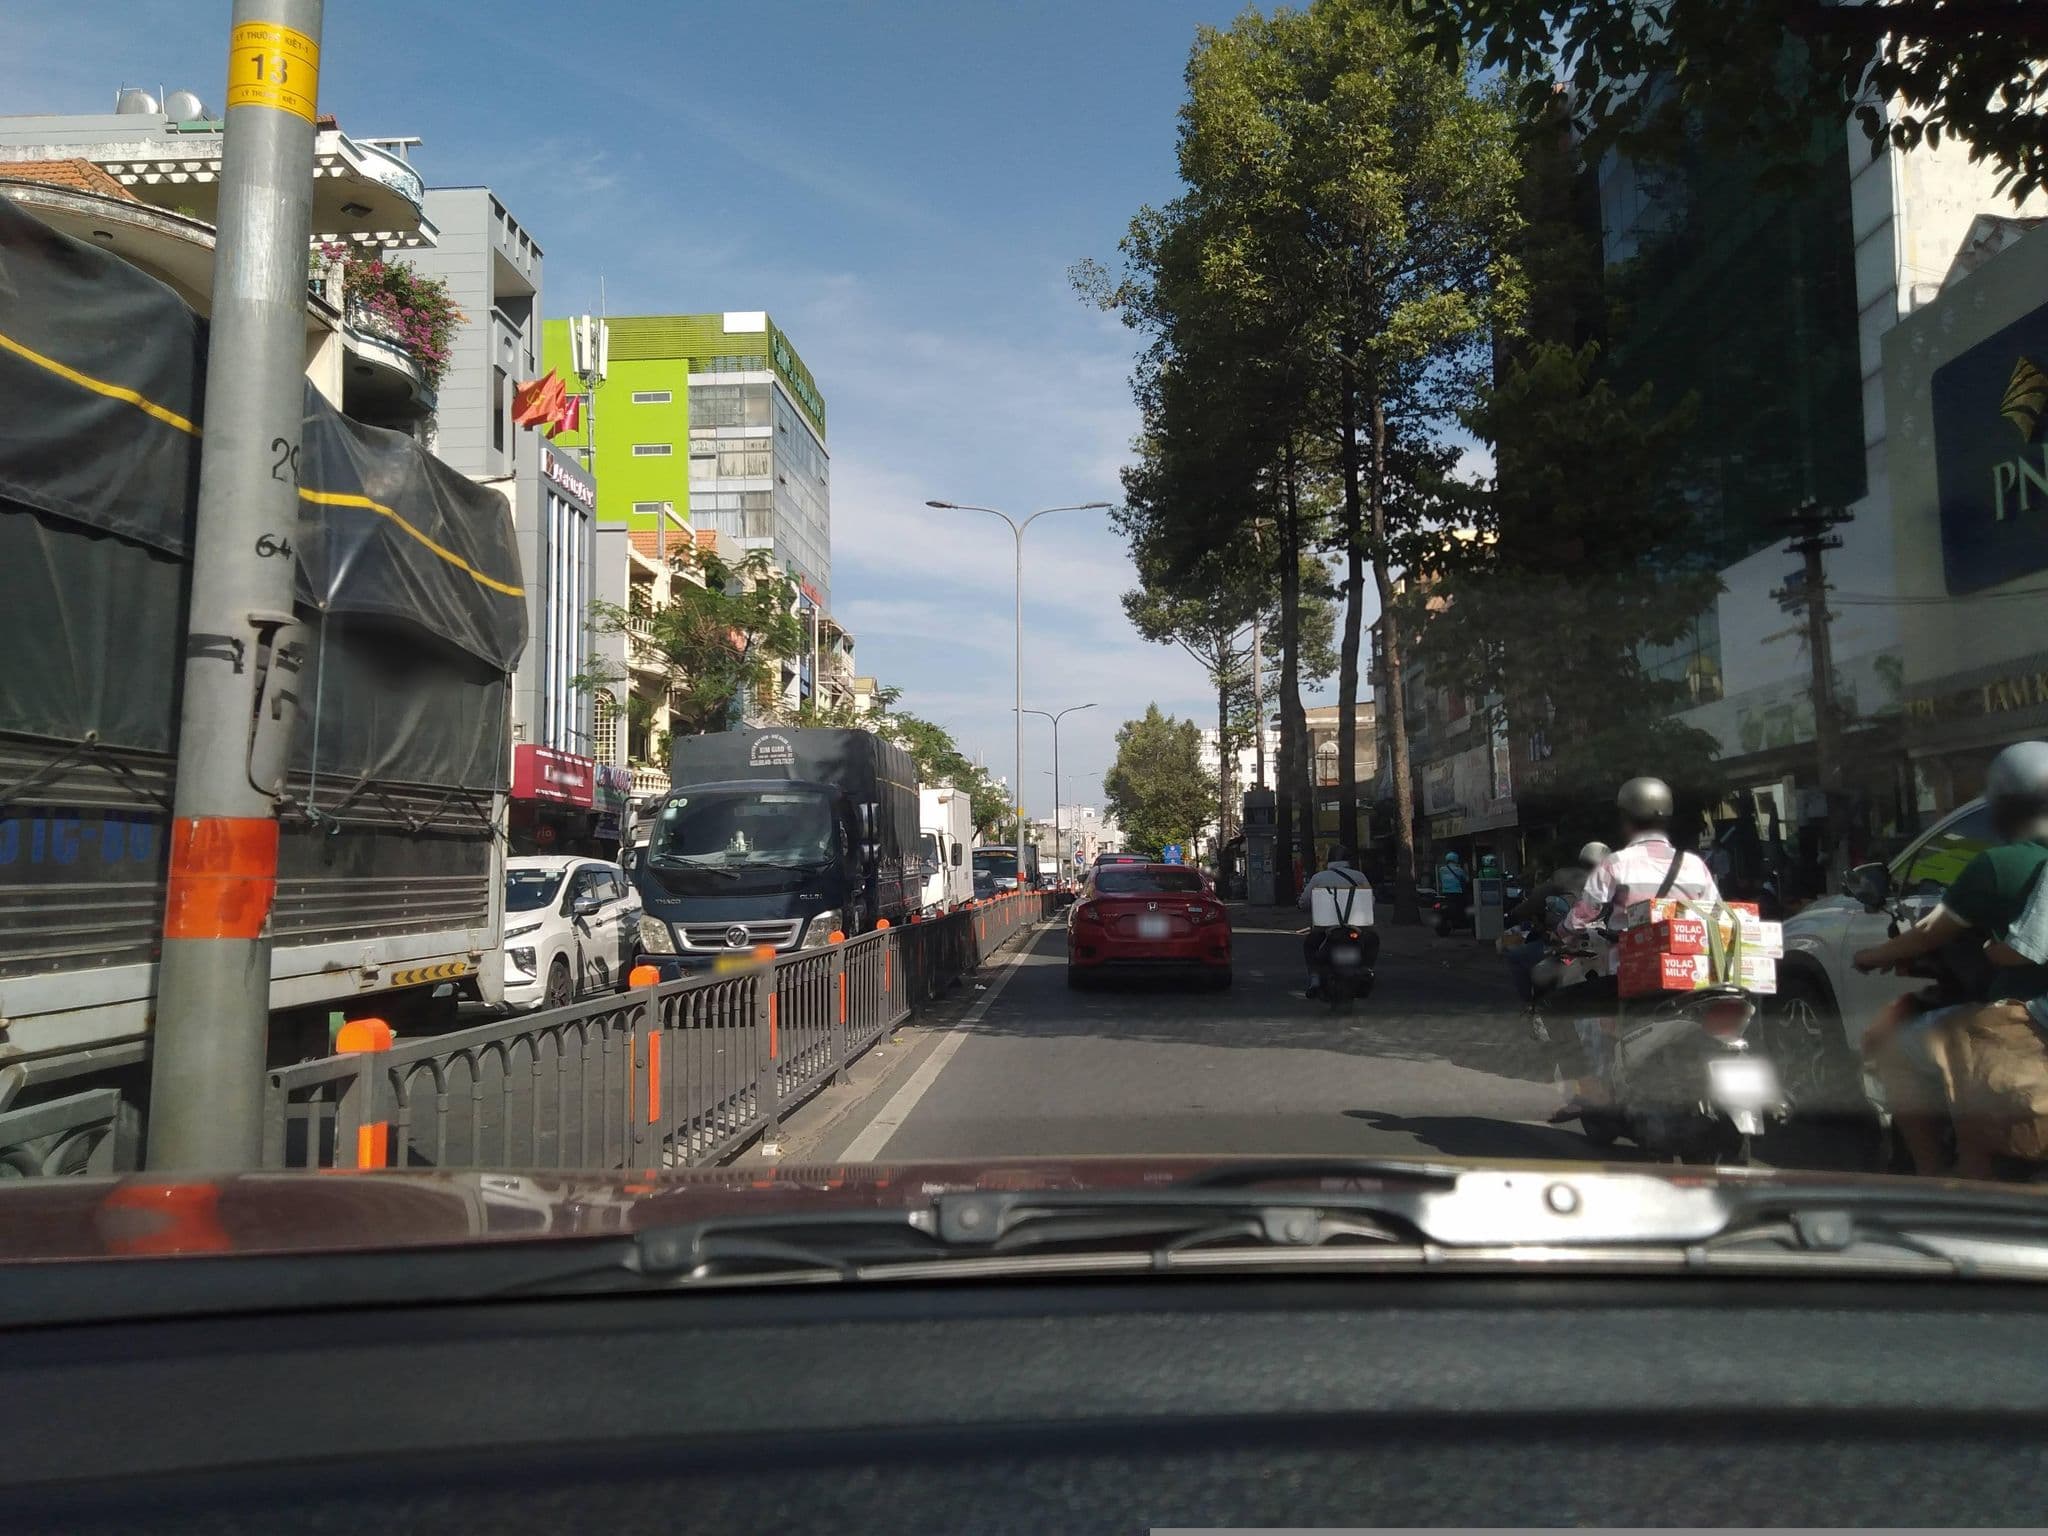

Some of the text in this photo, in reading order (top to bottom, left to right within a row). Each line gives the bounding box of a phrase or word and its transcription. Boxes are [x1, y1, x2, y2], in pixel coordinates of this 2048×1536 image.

[251, 53, 288, 84] 13
[255, 533, 293, 560] 64
[1673, 924, 1702, 934] YOLAC
[1674, 934, 1697, 943] MILK
[1664, 959, 1694, 969] YOLAC
[1665, 968, 1689, 977] MILK
